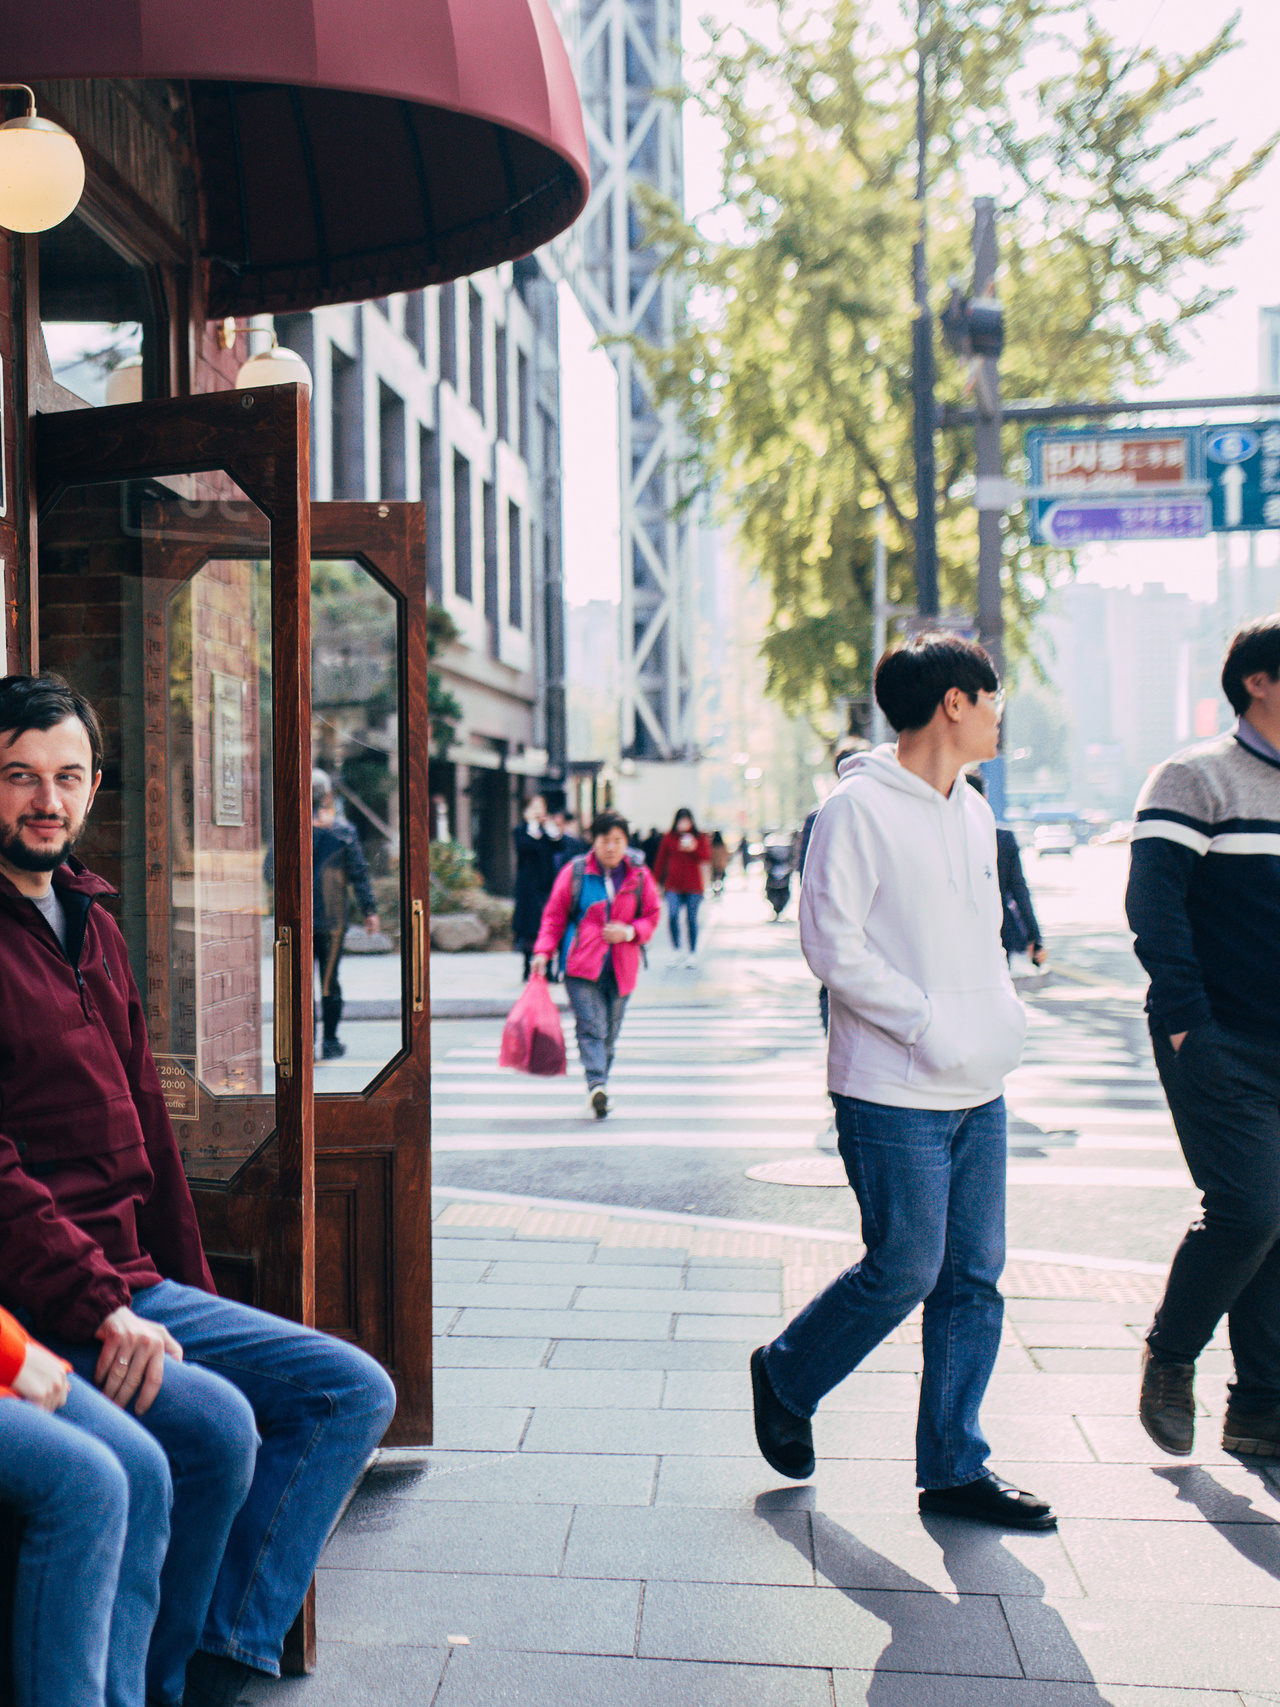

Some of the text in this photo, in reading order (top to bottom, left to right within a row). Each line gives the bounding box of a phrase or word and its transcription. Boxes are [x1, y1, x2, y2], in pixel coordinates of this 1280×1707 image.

[161, 1066, 186, 1076] 20:00
[161, 1079, 186, 1090] 20:00
[165, 1099, 186, 1109] coffee
